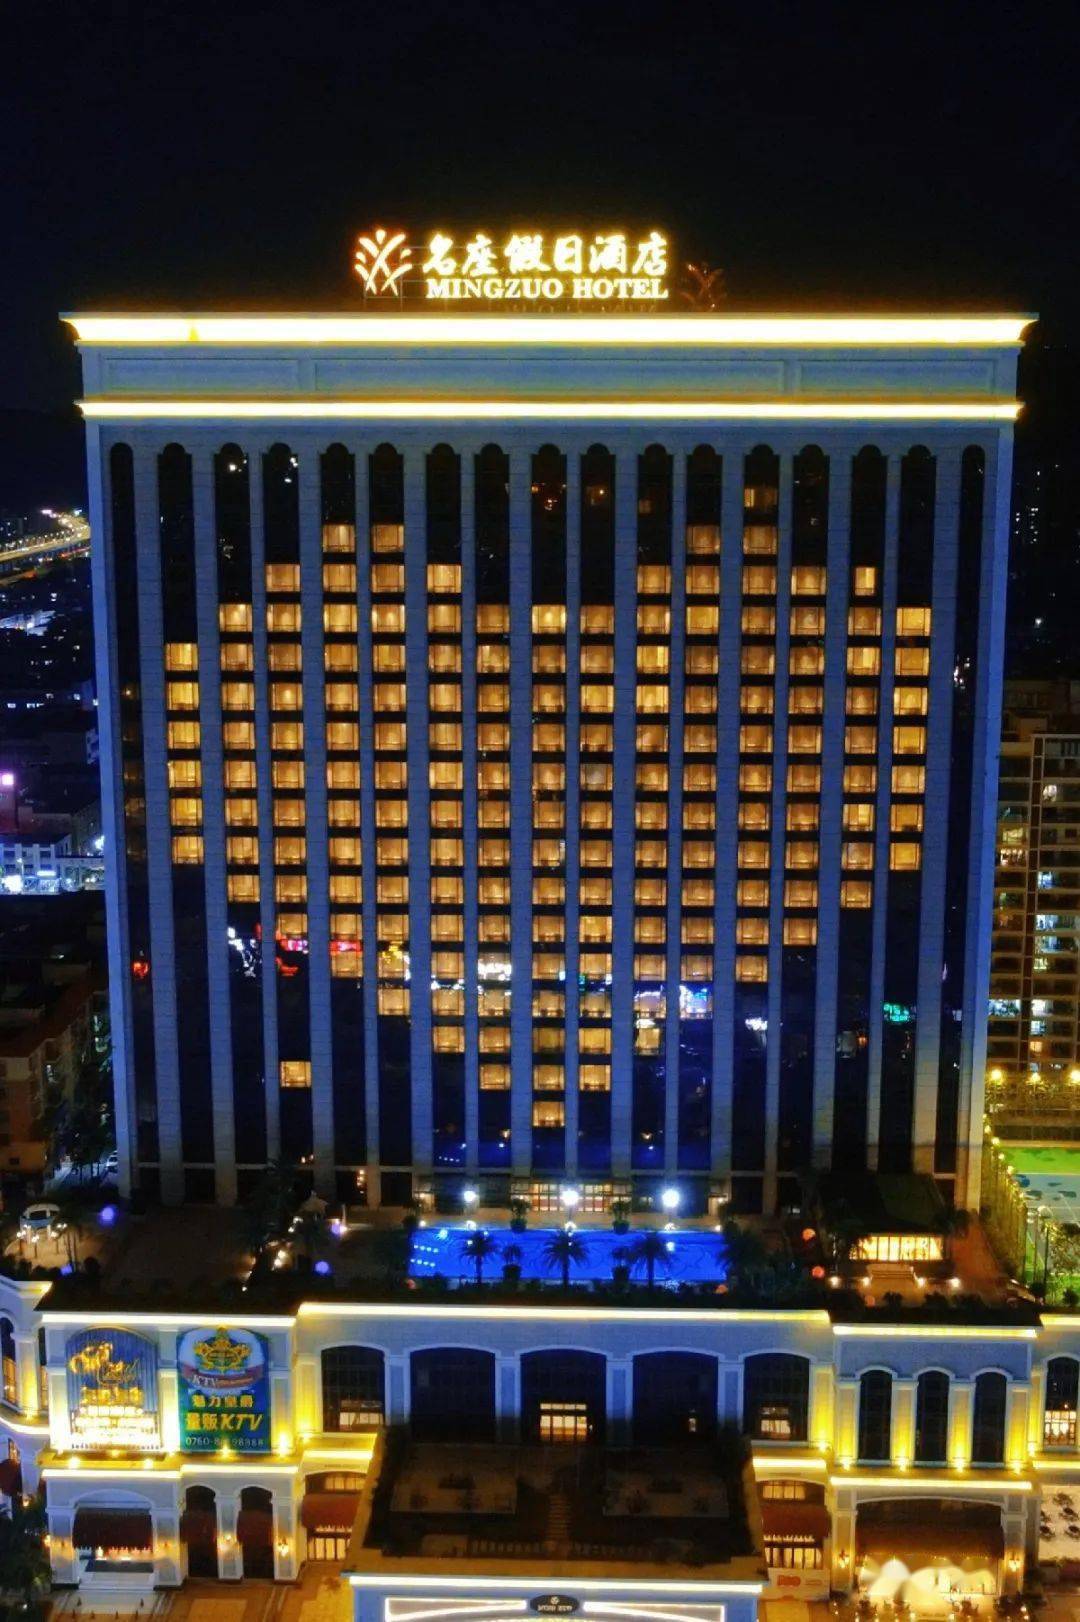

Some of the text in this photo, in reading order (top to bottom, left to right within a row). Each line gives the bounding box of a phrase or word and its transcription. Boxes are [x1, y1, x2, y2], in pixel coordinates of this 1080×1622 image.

[422, 233, 667, 276] 名座假日酒店
[425, 278, 669, 299] MINGZUO HOTEL
